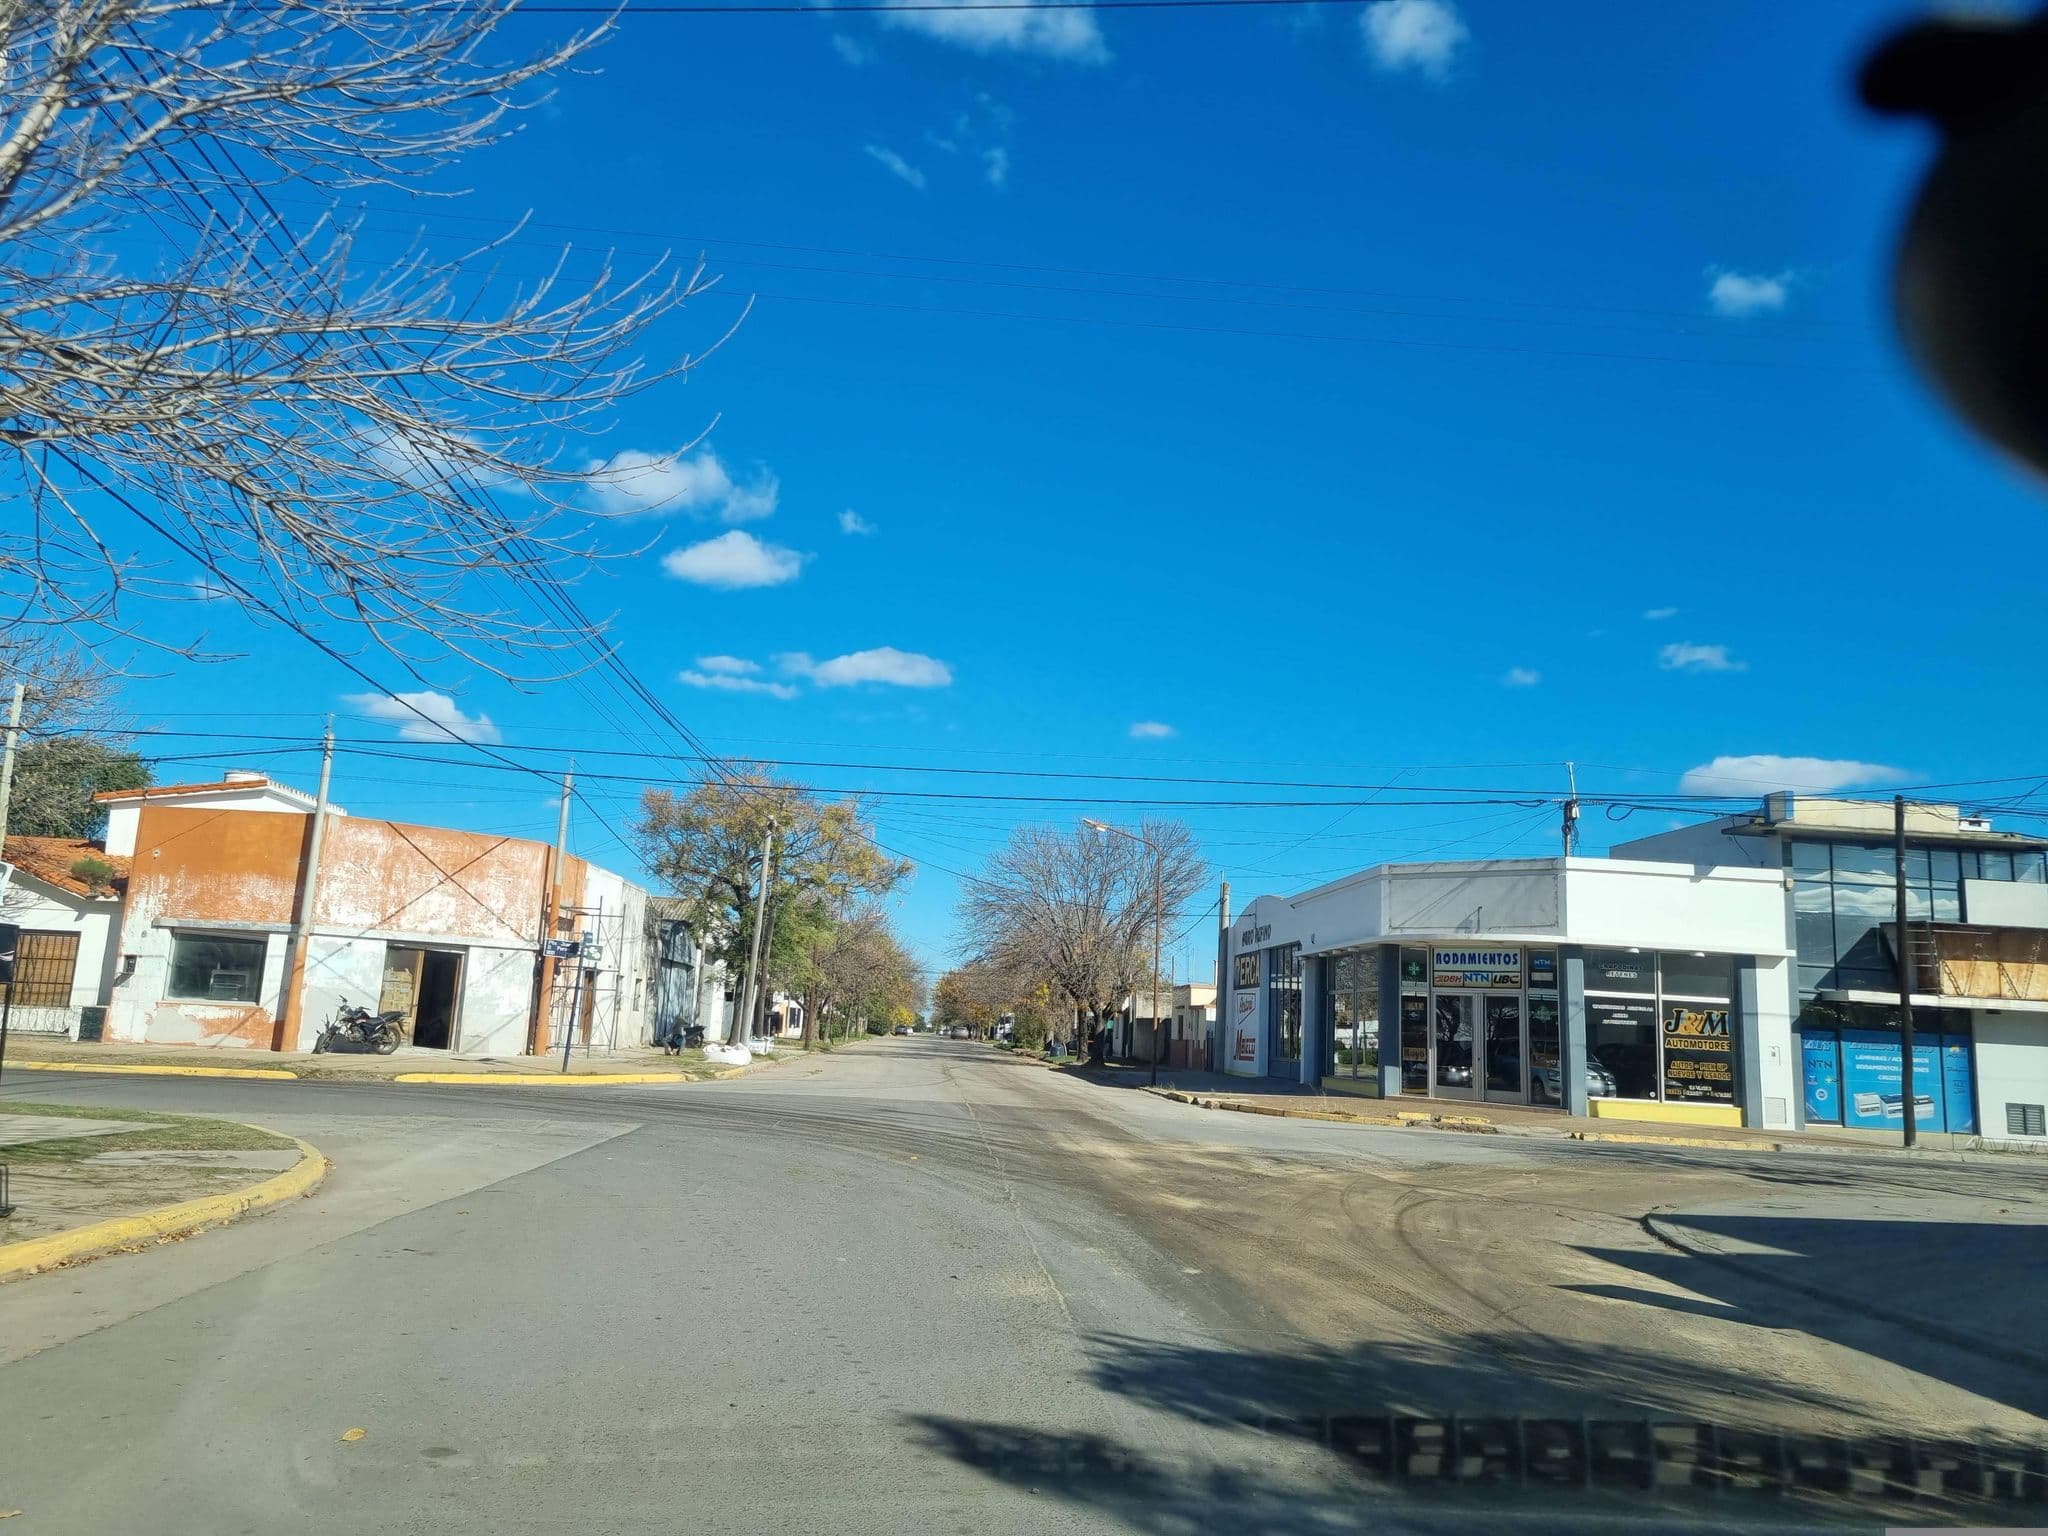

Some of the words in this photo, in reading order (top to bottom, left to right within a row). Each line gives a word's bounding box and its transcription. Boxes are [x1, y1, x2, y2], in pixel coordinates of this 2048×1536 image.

[1435, 952, 1519, 966] RODAMIENTOS
[1464, 972, 1490, 983] NTN
[1493, 974, 1520, 985] UBC
[1664, 1008, 1730, 1037] J&M
[1665, 1037, 1732, 1052] AUTOMOTORES
[1671, 1060, 1694, 1069] AUTOS
[1699, 1062, 1717, 1071] PICK
[1717, 1063, 1728, 1071] UP
[1808, 1059, 1833, 1070] NTN
[1667, 1069, 1696, 1078] NUEVOS
[1696, 1070, 1703, 1079] Y
[1703, 1071, 1732, 1081] USADOS
